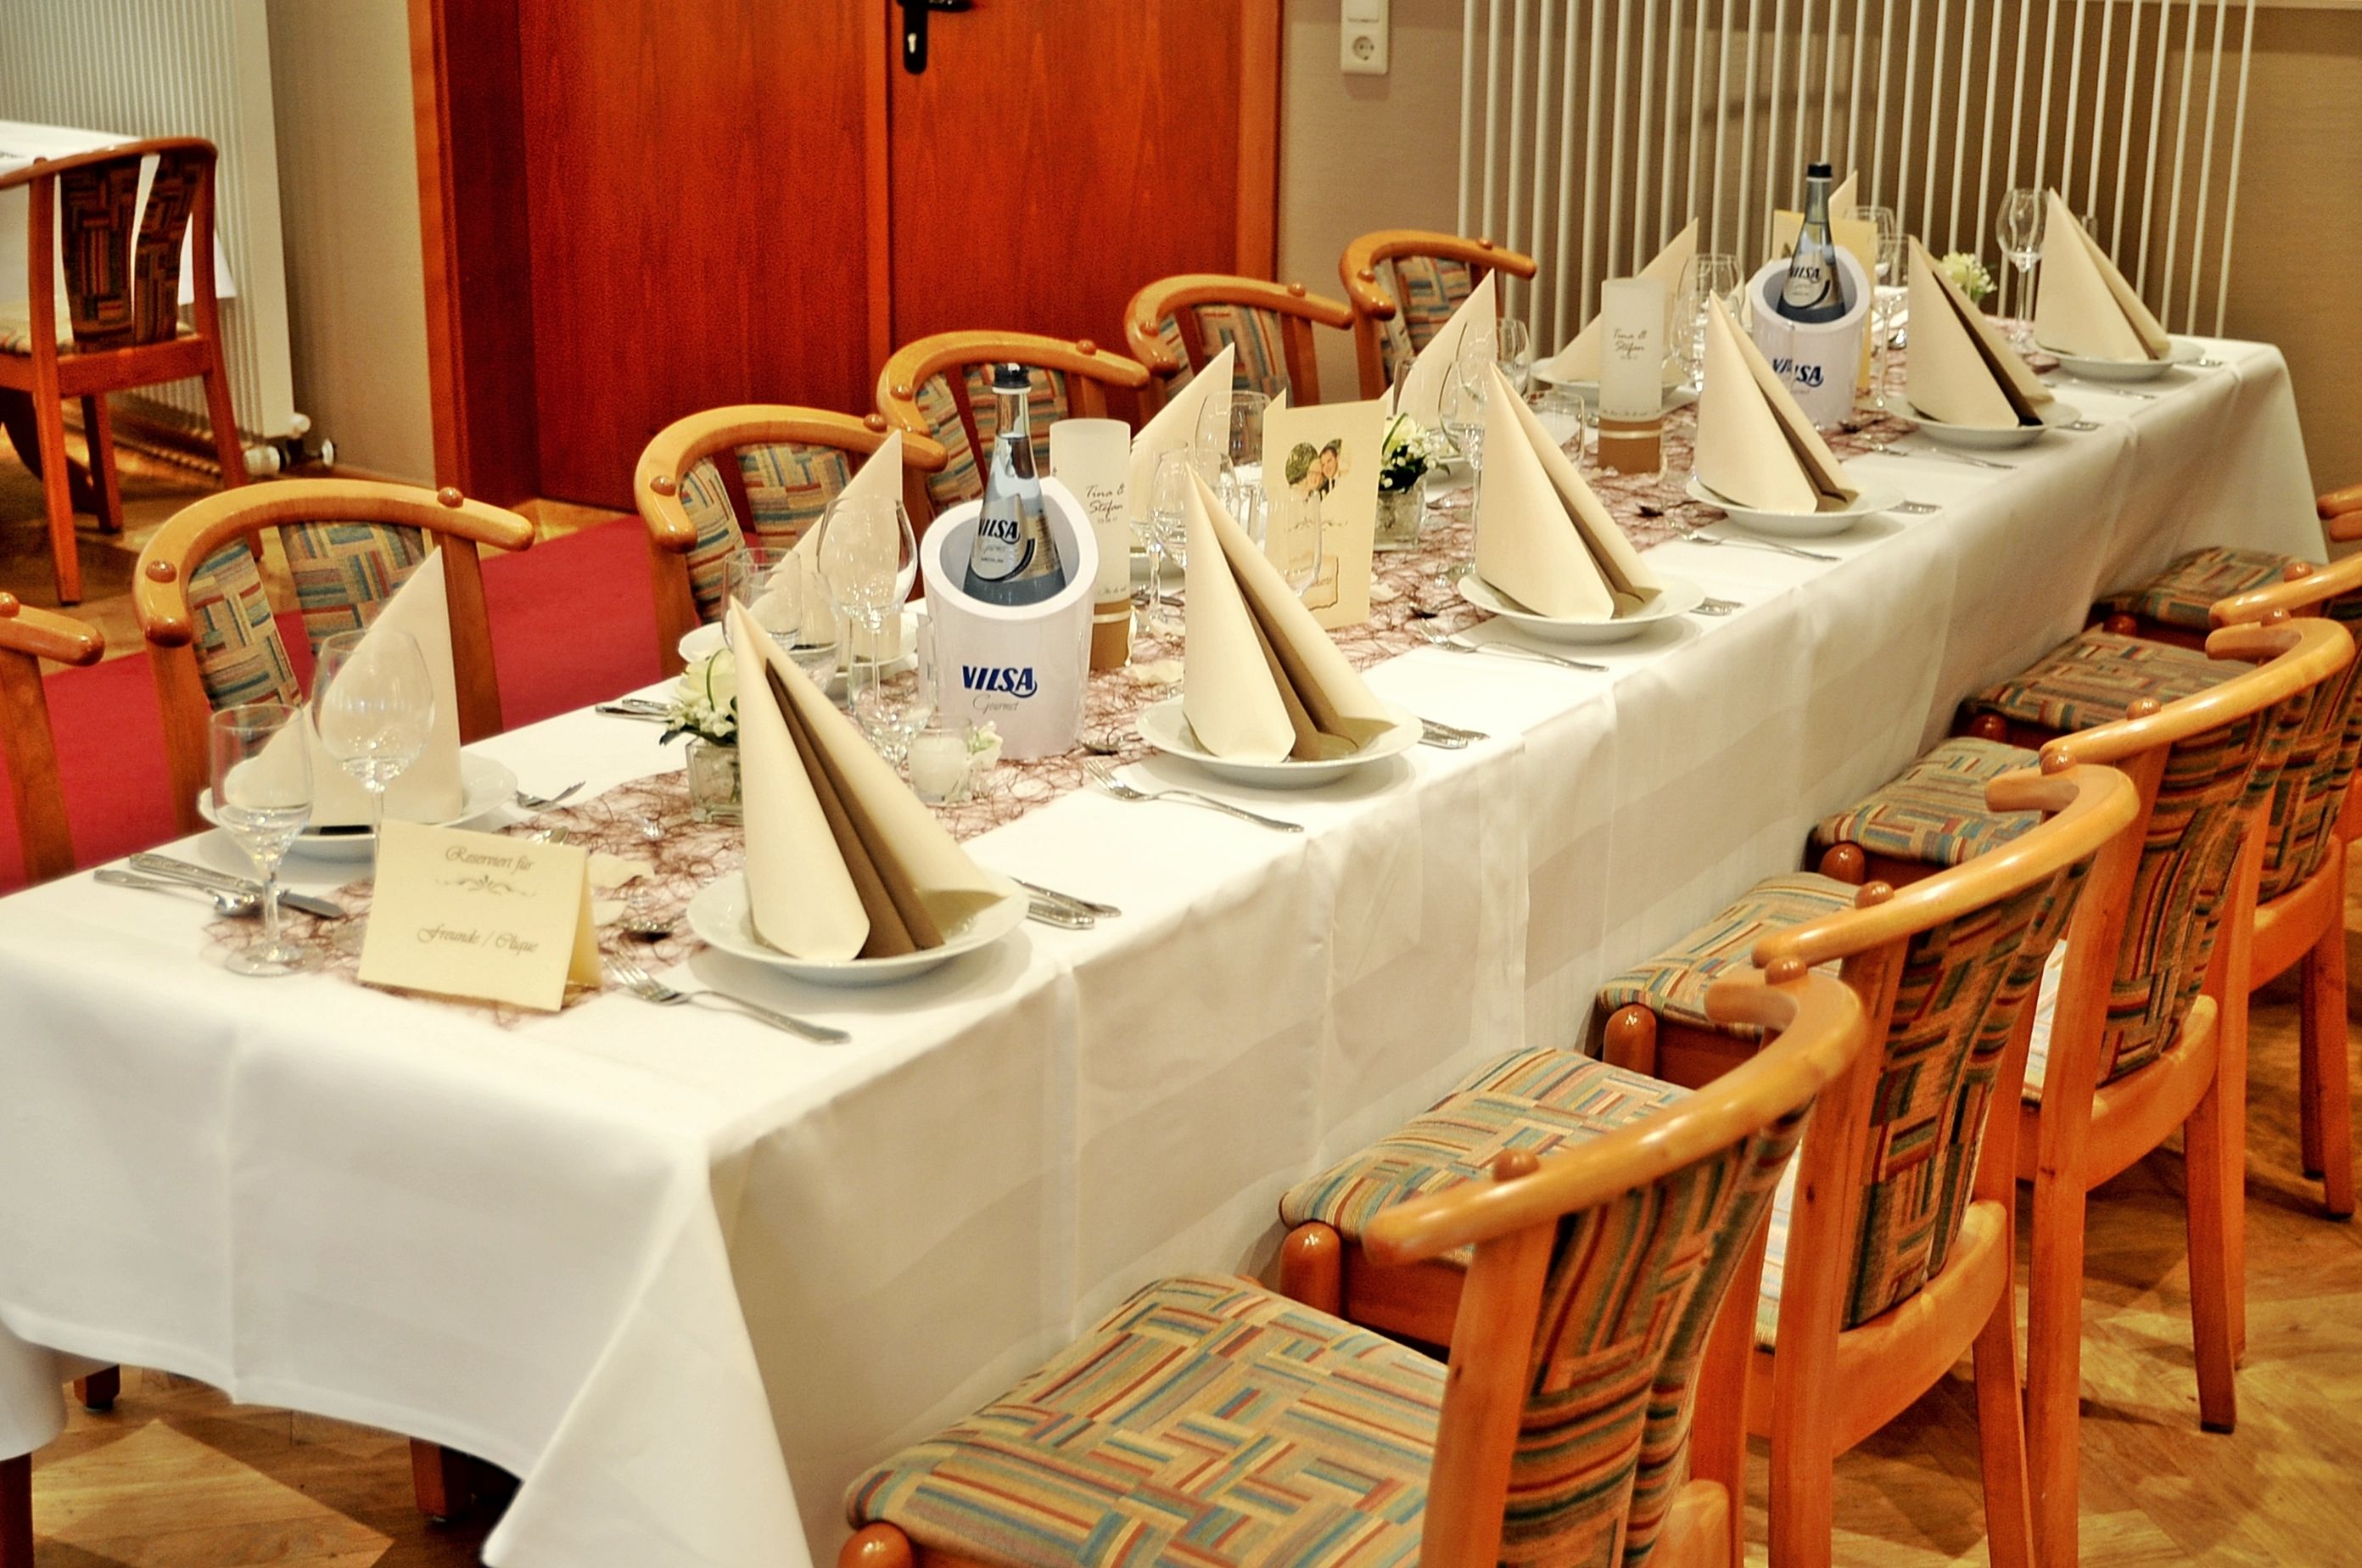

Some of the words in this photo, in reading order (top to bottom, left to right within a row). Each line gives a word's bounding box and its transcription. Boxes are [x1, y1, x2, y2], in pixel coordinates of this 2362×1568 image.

[1790, 266, 1821, 283] VILSA
[1615, 340, 1644, 356] Stefan
[1086, 484, 1112, 497] Tina
[1089, 499, 1122, 518] Stefan
[978, 518, 1021, 543] VILSA
[962, 665, 1038, 697] VILSA
[972, 694, 1019, 714] Gourmet
[445, 846, 512, 868] Reserviert
[512, 855, 535, 872] für
[417, 924, 480, 945] Freunde
[495, 933, 540, 957] Clique
